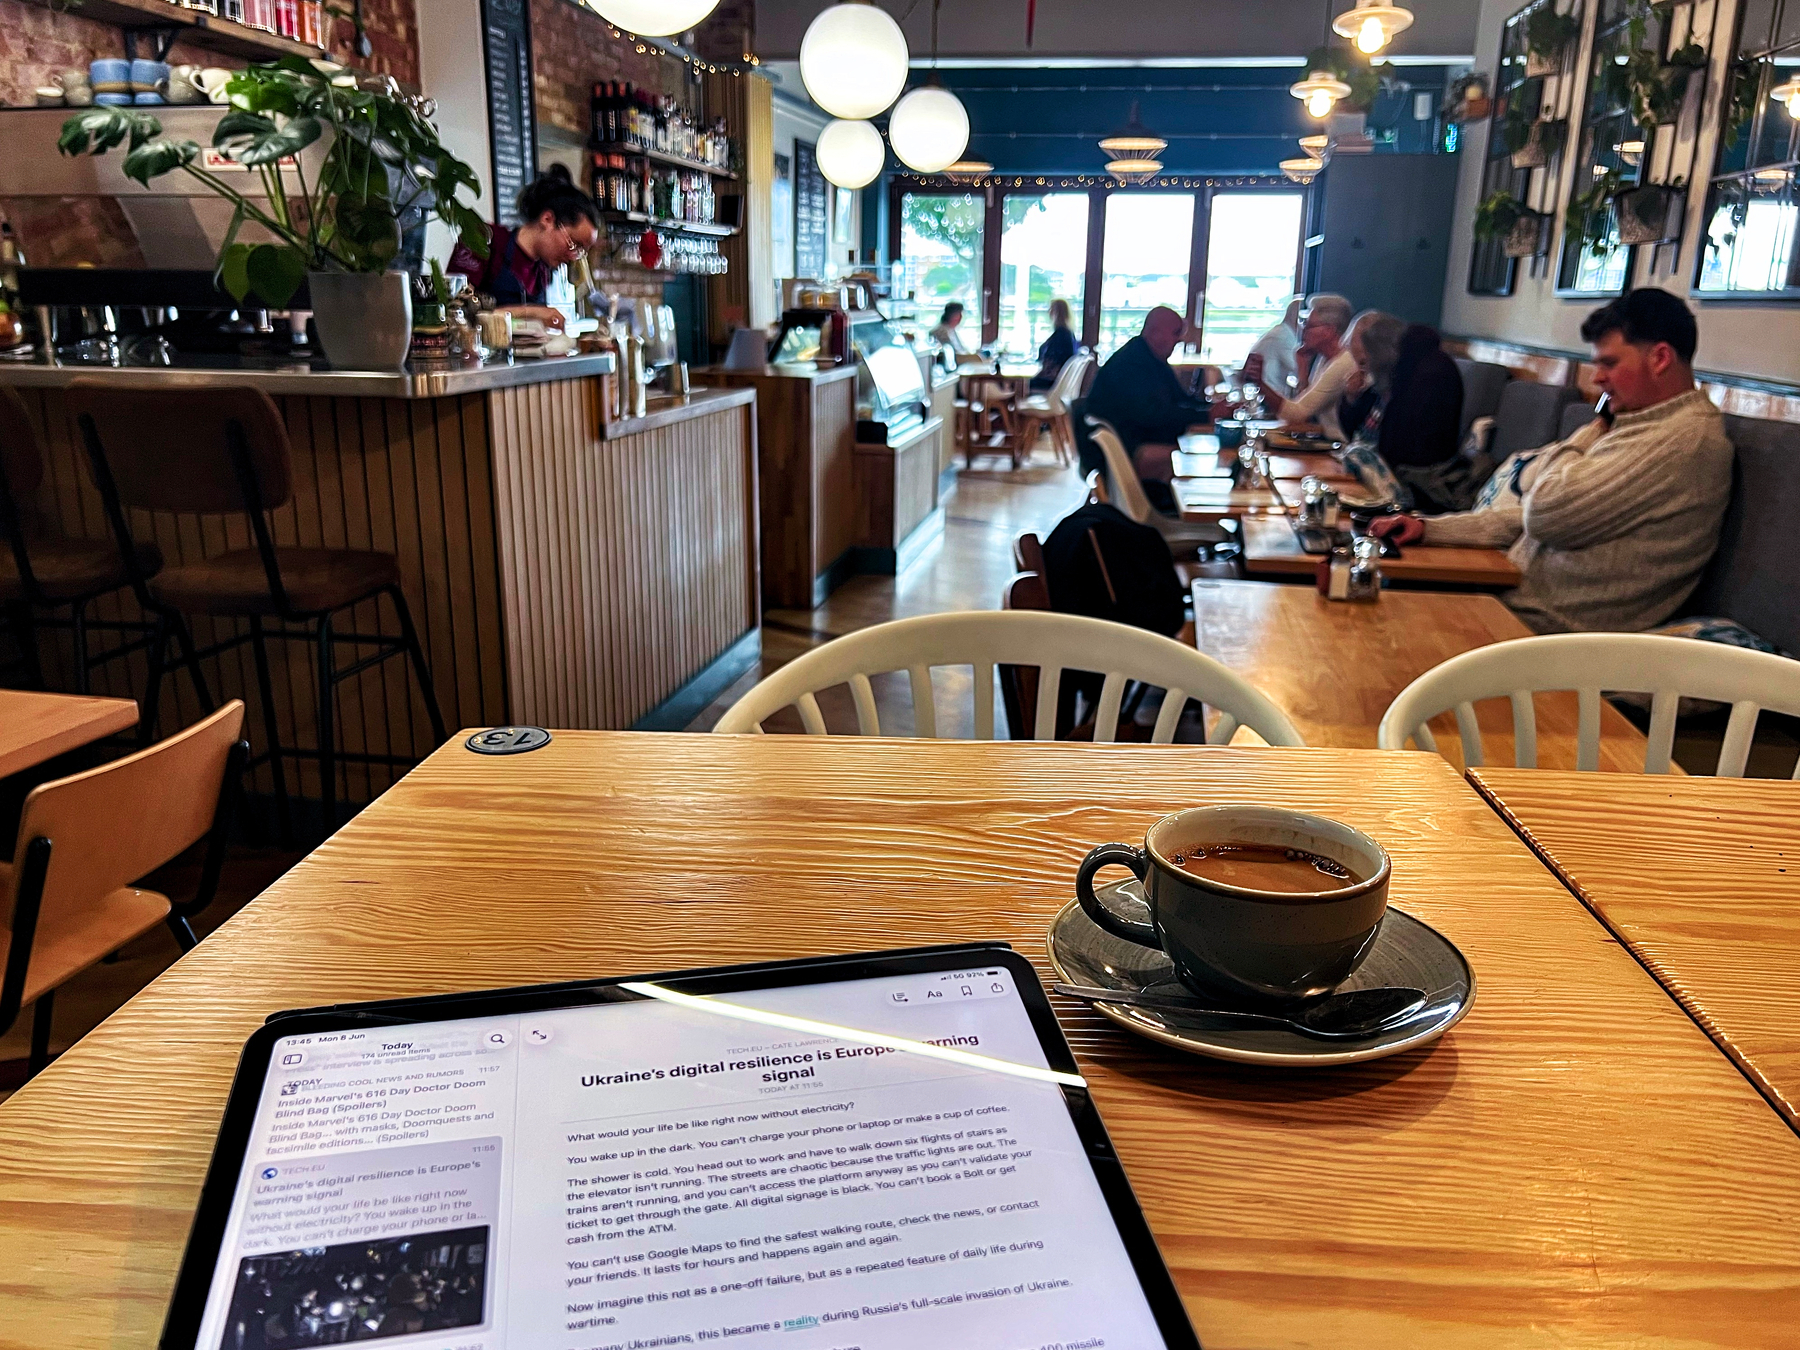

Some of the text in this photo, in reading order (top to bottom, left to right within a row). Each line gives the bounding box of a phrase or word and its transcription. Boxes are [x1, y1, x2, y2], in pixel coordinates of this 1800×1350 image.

[482, 732, 532, 746] 13
[426, 1070, 464, 1078] RUMORS
[581, 1035, 978, 1087] Ukraine's digital resilience is Europ arning
[762, 1066, 815, 1083] signal
[278, 1097, 312, 1108] Inside
[315, 1092, 362, 1103] Marvel's
[366, 1088, 386, 1098] 616
[414, 1084, 450, 1093] Doctor
[454, 1080, 486, 1088] Doom
[287, 1078, 322, 1088] TODAY
[758, 1086, 787, 1094] TODAY
[276, 1100, 386, 1118] Blind Bag (Spoilers)
[567, 1132, 595, 1142] What
[597, 1128, 629, 1139] would
[632, 1126, 655, 1136] your
[657, 1123, 673, 1132] life
[691, 1120, 709, 1128] like
[711, 1116, 735, 1126] right
[761, 1108, 798, 1119] without
[800, 1101, 854, 1114] electricity?
[590, 1152, 618, 1162] wake
[620, 1150, 634, 1158] up
[649, 1146, 666, 1154] the
[669, 1142, 695, 1152] dark.
[720, 1136, 746, 1146] can't
[748, 1132, 784, 1142] charge
[787, 1129, 809, 1139] your
[812, 1125, 844, 1136] phone
[859, 1120, 891, 1129] laptop
[905, 1114, 932, 1123] make
[976, 1106, 1010, 1114] coffee.
[567, 1178, 588, 1187] The
[591, 1174, 630, 1184] shower
[644, 1167, 671, 1177] cold.
[696, 1160, 723, 1171] head
[725, 1159, 743, 1167] out
[759, 1153, 785, 1163] work
[787, 1150, 807, 1160] and
[809, 1148, 833, 1157] have
[849, 1142, 872, 1152] walk
[874, 1140, 902, 1149] down
[920, 1134, 952, 1144] flights
[953, 1131, 963, 1139] of
[966, 1128, 993, 1137] stairs
[317, 1174, 354, 1188] digital
[357, 1170, 414, 1181] resilience
[417, 1166, 427, 1174] is
[430, 1161, 481, 1172] Europe's
[254, 1188, 343, 1206] warning signal
[567, 1261, 589, 1270] You
[592, 1255, 620, 1267] can't
[623, 1253, 644, 1262] use
[647, 1246, 688, 1260] Google
[691, 1243, 722, 1254] Maps
[739, 1237, 761, 1247] find
[763, 1235, 782, 1244] the
[784, 1230, 818, 1241] safest
[820, 1224, 862, 1236] walking
[864, 1220, 895, 1230] route,
[898, 1214, 931, 1225] check
[933, 1212, 950, 1220] the
[953, 1208, 984, 1218] news,
[999, 1200, 1039, 1211] contact
[567, 1276, 591, 1287] your
[596, 1270, 640, 1281] friends.
[654, 1264, 680, 1273] lasts
[703, 1257, 734, 1266] hours
[738, 1253, 758, 1262] and
[762, 1247, 809, 1258] happens
[813, 1242, 842, 1252] again
[845, 1238, 866, 1247] and
[869, 1234, 902, 1245] again.
[566, 1303, 594, 1313] Now
[597, 1296, 644, 1309] imagine
[646, 1292, 668, 1302] this
[671, 1288, 691, 1299] not
[694, 1287, 707, 1296] as
[710, 1285, 717, 1294] a
[720, 1277, 763, 1292] one-off
[765, 1274, 804, 1286] failure,
[807, 1270, 826, 1280] but
[829, 1268, 842, 1277] as
[855, 1258, 905, 1273] repeated
[906, 1253, 946, 1266] feature
[948, 1249, 959, 1260] of
[962, 1247, 987, 1258] daily
[989, 1245, 1006, 1254] life
[1009, 1240, 1044, 1251] during
[566, 1316, 618, 1330] wartime.
[697, 1329, 720, 1338] this
[722, 1322, 770, 1335] became
[783, 1316, 818, 1328] reality
[821, 1309, 860, 1322] during
[861, 1302, 908, 1315] Russia's
[910, 1293, 963, 1308] full-scale
[965, 1287, 1011, 1301] invasion
[1013, 1283, 1024, 1294] of
[1066, 1338, 1104, 1350] missile
